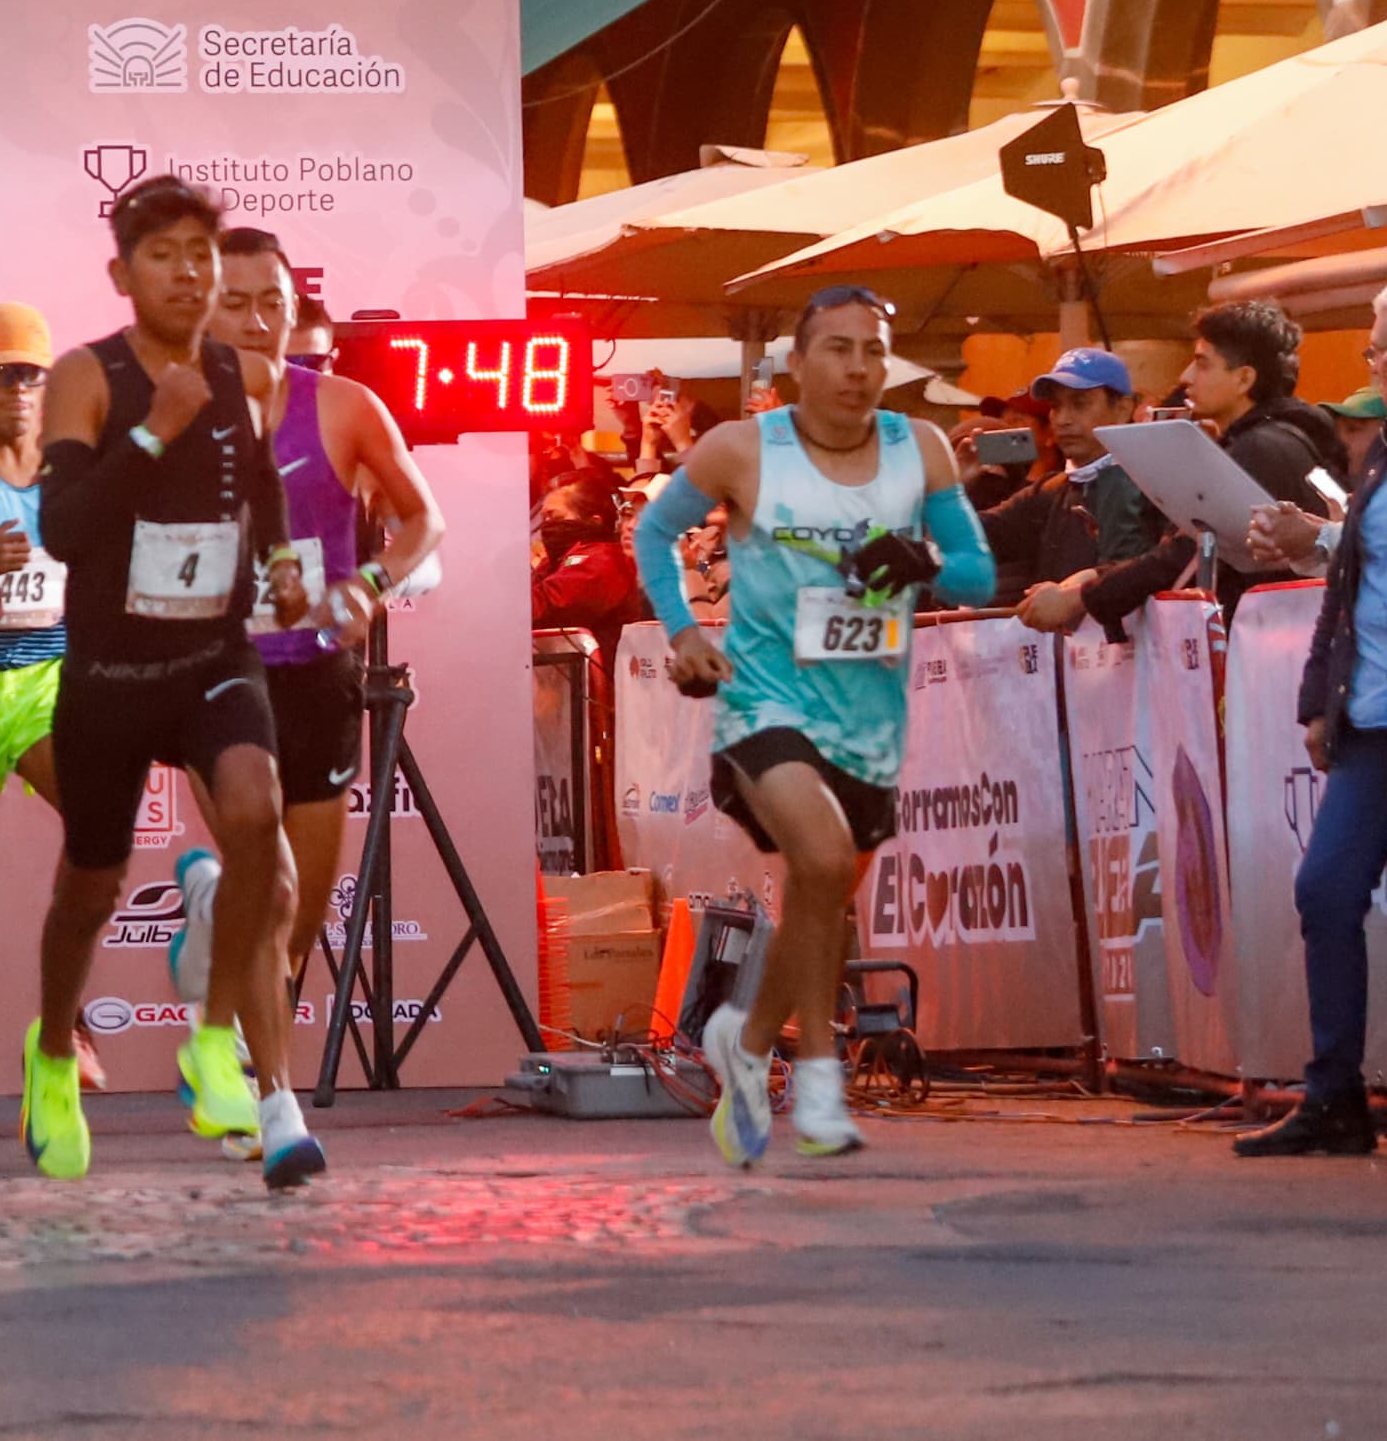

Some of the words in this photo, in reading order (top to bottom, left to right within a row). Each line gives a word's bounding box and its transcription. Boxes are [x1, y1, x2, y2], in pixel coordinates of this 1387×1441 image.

[203, 29, 352, 57] Secretaría
[204, 63, 240, 88] de
[250, 61, 401, 88] Educación
[167, 158, 290, 183] Instituto
[300, 157, 413, 183] Poblano
[1024, 152, 1066, 166] SHURE
[221, 188, 335, 217] Deporte
[178, 551, 201, 589] 4
[822, 615, 884, 652] 623
[649, 791, 680, 813] Comex
[106, 924, 172, 944] Julb
